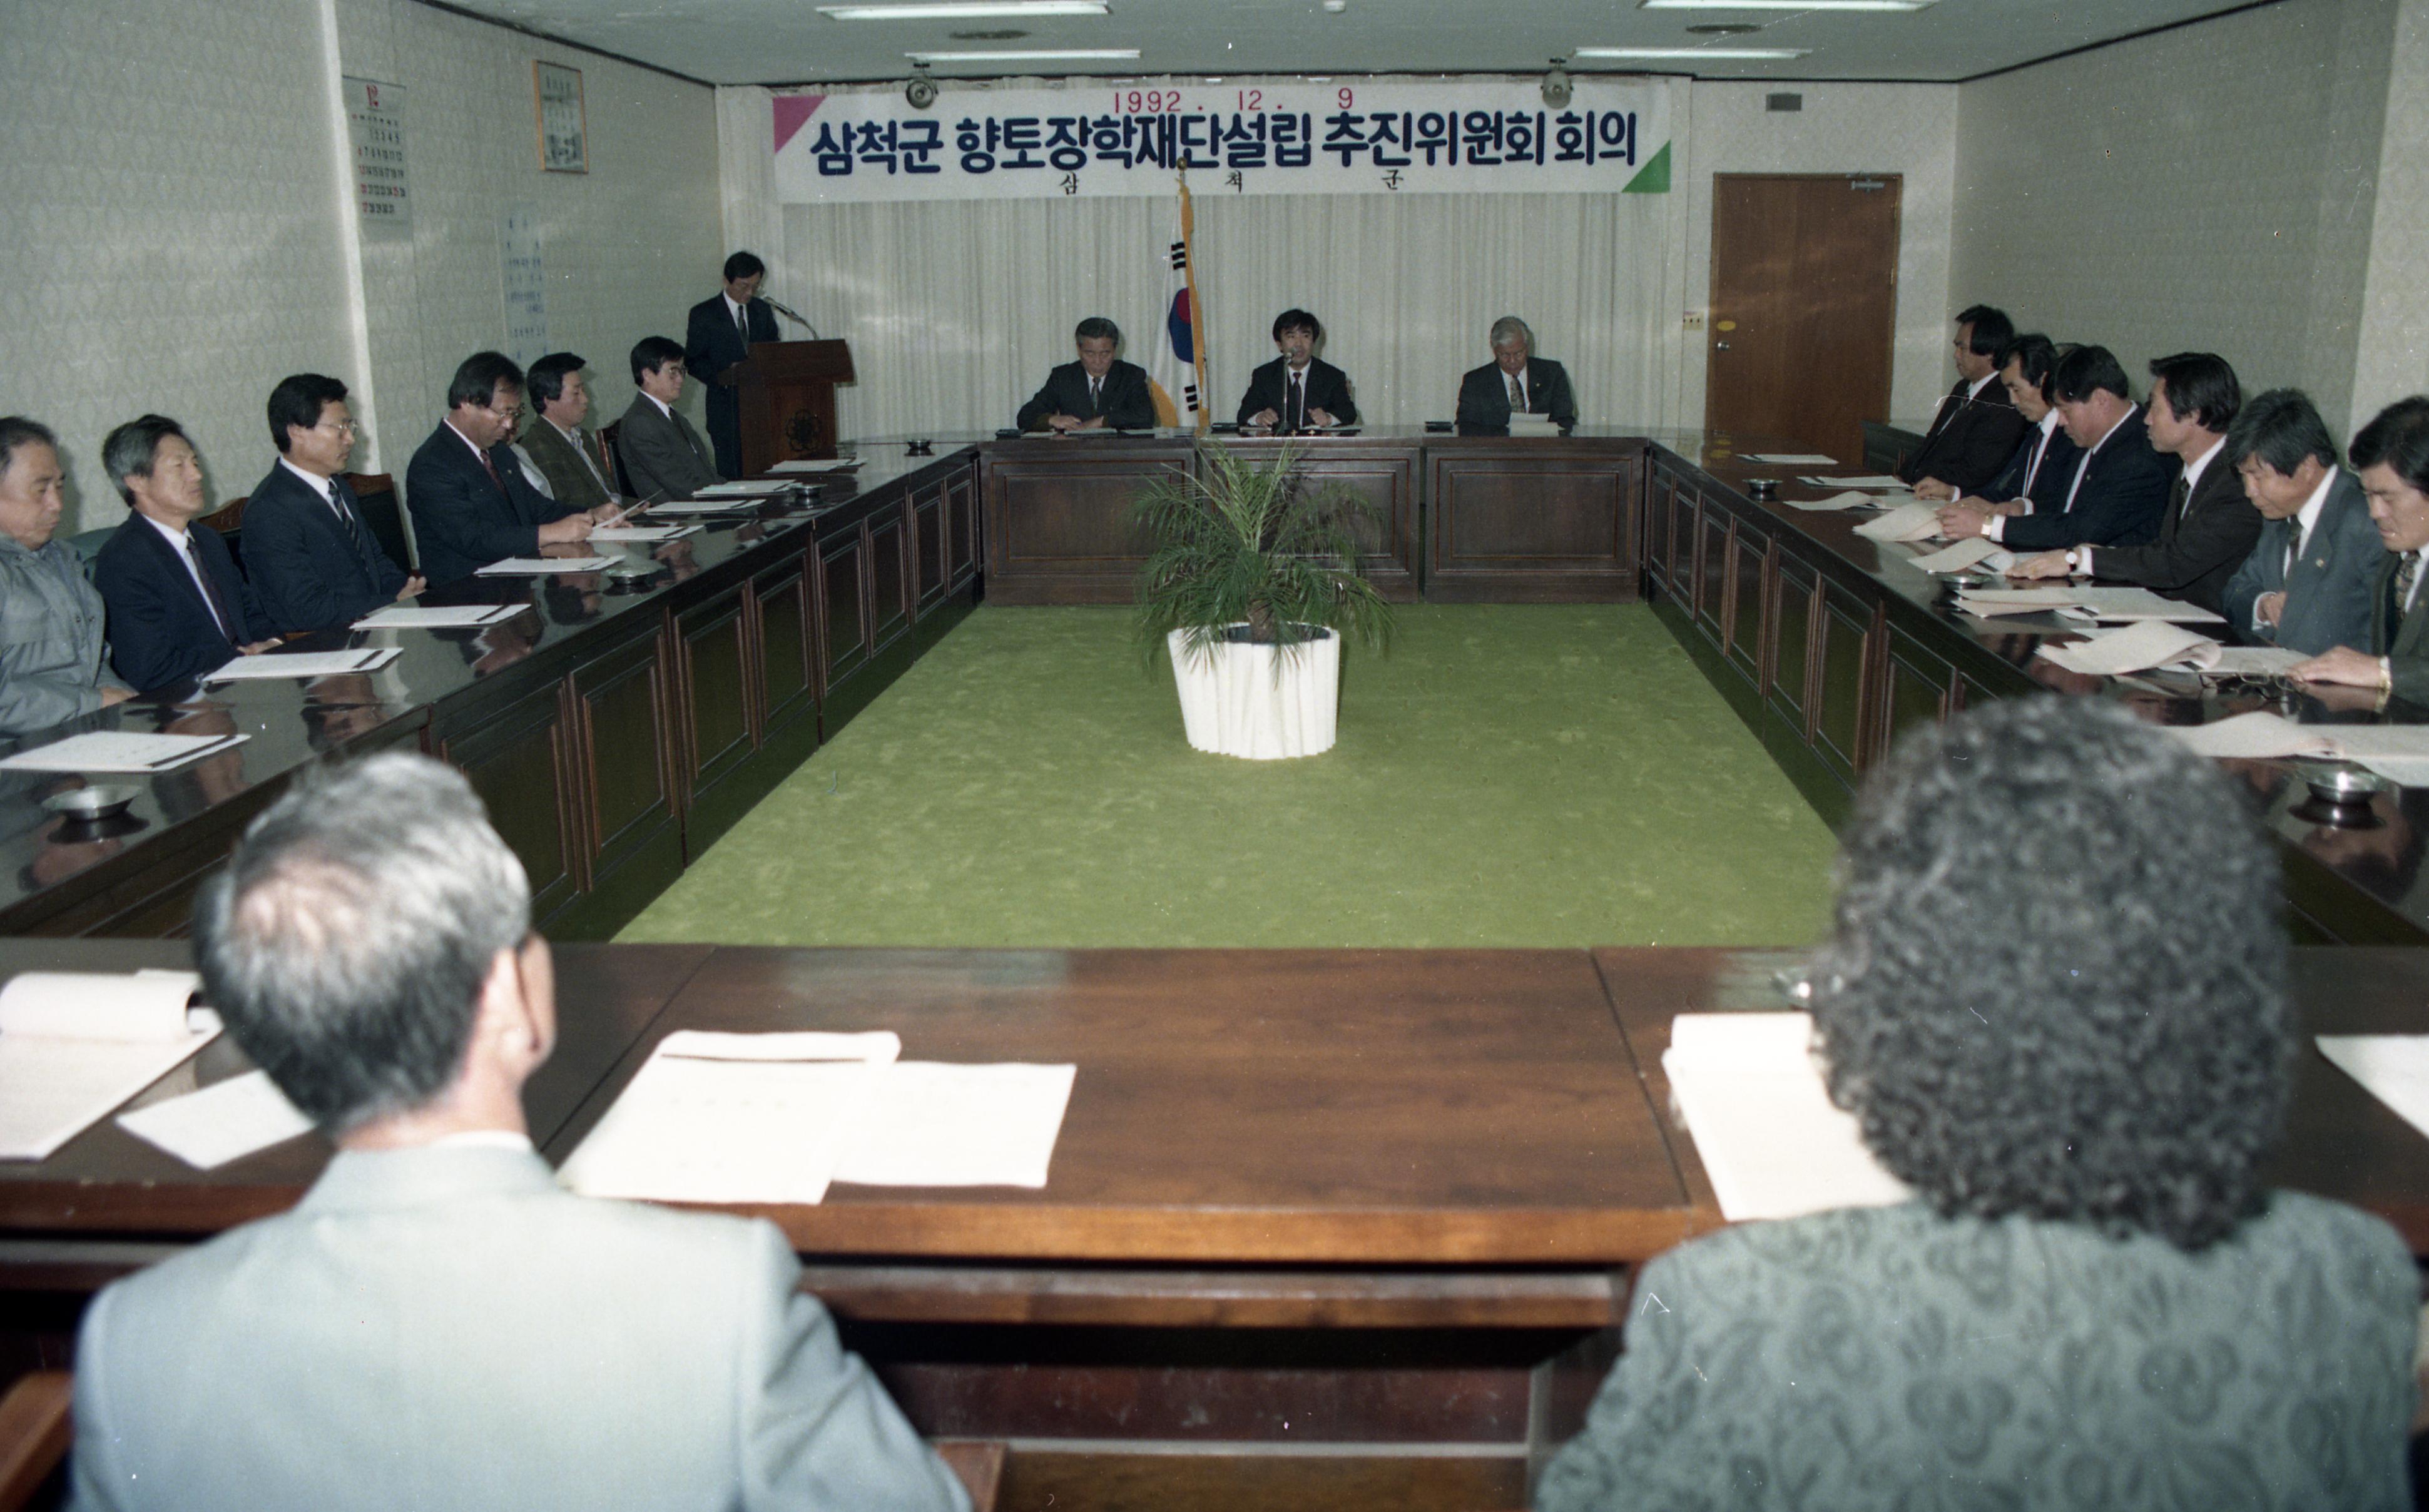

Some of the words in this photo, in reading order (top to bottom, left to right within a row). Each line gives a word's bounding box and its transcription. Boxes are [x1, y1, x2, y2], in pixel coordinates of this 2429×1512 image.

[1338, 88, 1353, 109] 9
[810, 120, 944, 176] 삼척군
[1322, 111, 1545, 167] 추진위원회
[1554, 111, 1636, 166] 회의
